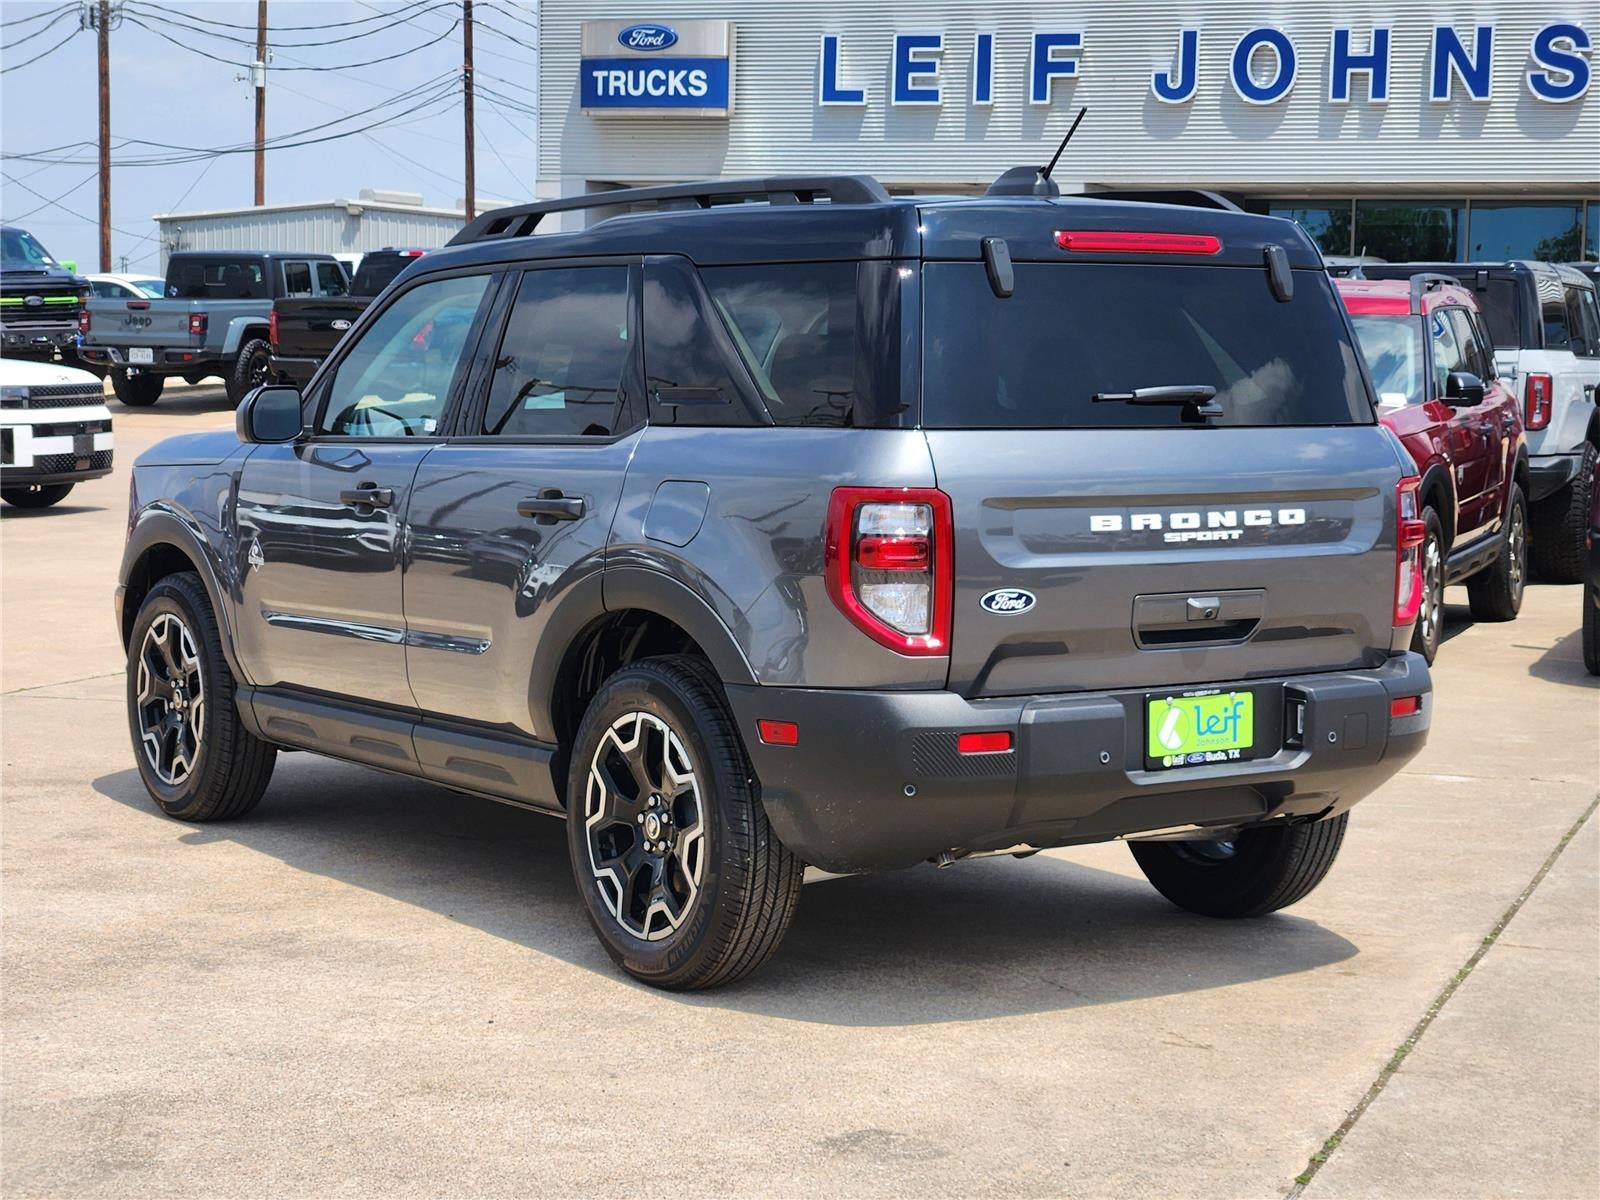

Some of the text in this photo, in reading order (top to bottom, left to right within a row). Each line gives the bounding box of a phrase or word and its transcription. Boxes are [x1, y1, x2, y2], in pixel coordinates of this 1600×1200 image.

[628, 28, 666, 46] Ford
[819, 22, 1594, 106] LEIF JOHNS
[593, 69, 708, 97] TRUCKS
[124, 313, 153, 327] Jeep
[1089, 508, 1306, 532] BRONCO
[1163, 529, 1244, 543] SPORT
[990, 591, 1028, 611] Ford
[1194, 701, 1244, 742] leif
[1228, 749, 1241, 759] TX
